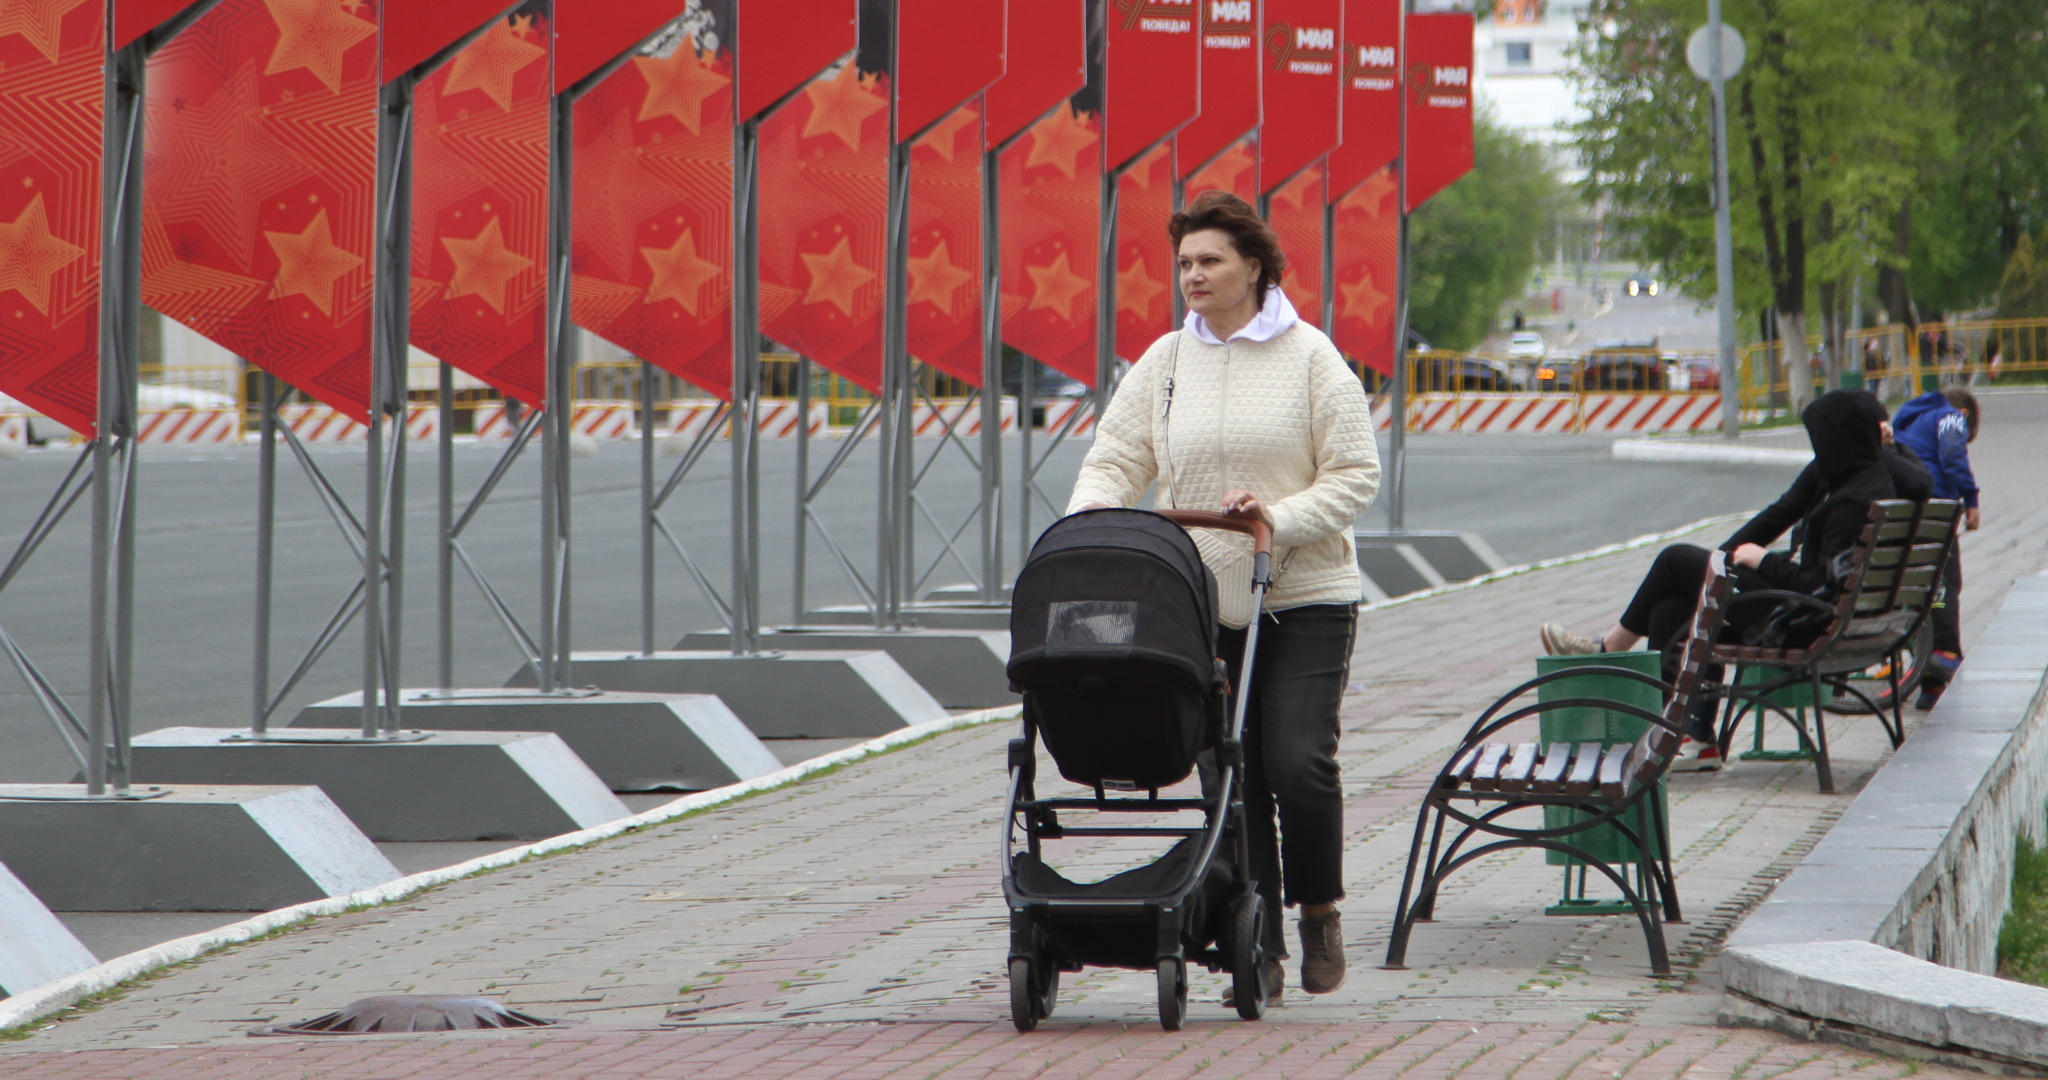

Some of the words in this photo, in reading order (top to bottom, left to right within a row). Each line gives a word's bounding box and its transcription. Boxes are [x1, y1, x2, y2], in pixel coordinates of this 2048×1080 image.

[1212, 0, 1252, 22] МАЯ
[1141, 18, 1191, 33] ПОБЕДА!
[1205, 35, 1251, 49] ПОБЕДА!
[1296, 27, 1334, 50] МАЯ
[1359, 46, 1395, 67] МАЯ
[1290, 61, 1333, 75] ПОБЕДА!
[1435, 66, 1468, 87] МАЯ
[1354, 78, 1394, 91] ПОБЕДА!
[1429, 95, 1467, 108] ПОБЕДА!
